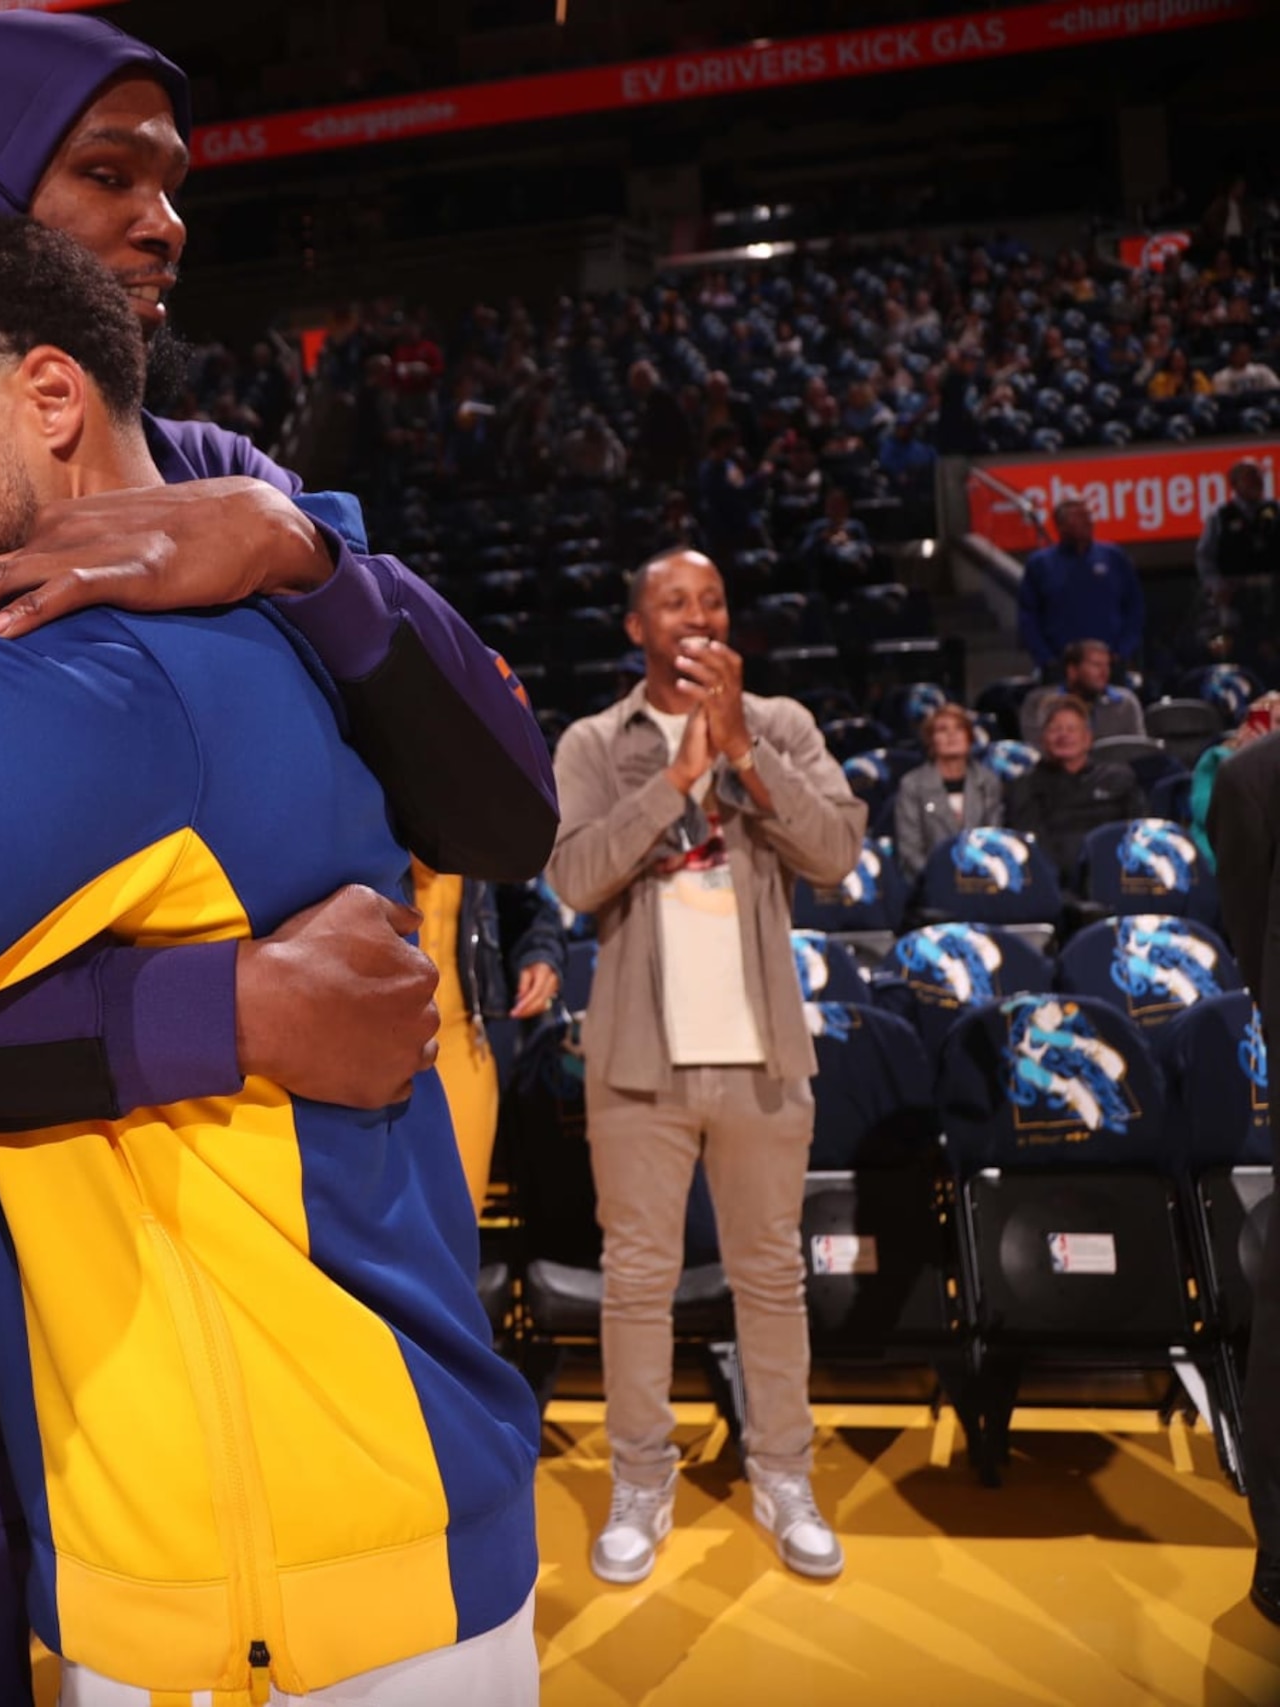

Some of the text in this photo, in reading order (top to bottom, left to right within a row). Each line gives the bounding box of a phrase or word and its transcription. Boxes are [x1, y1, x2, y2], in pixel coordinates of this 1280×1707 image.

[622, 18, 1007, 99] EV DRIVERS KICK GAS
[202, 124, 267, 158] GAS
